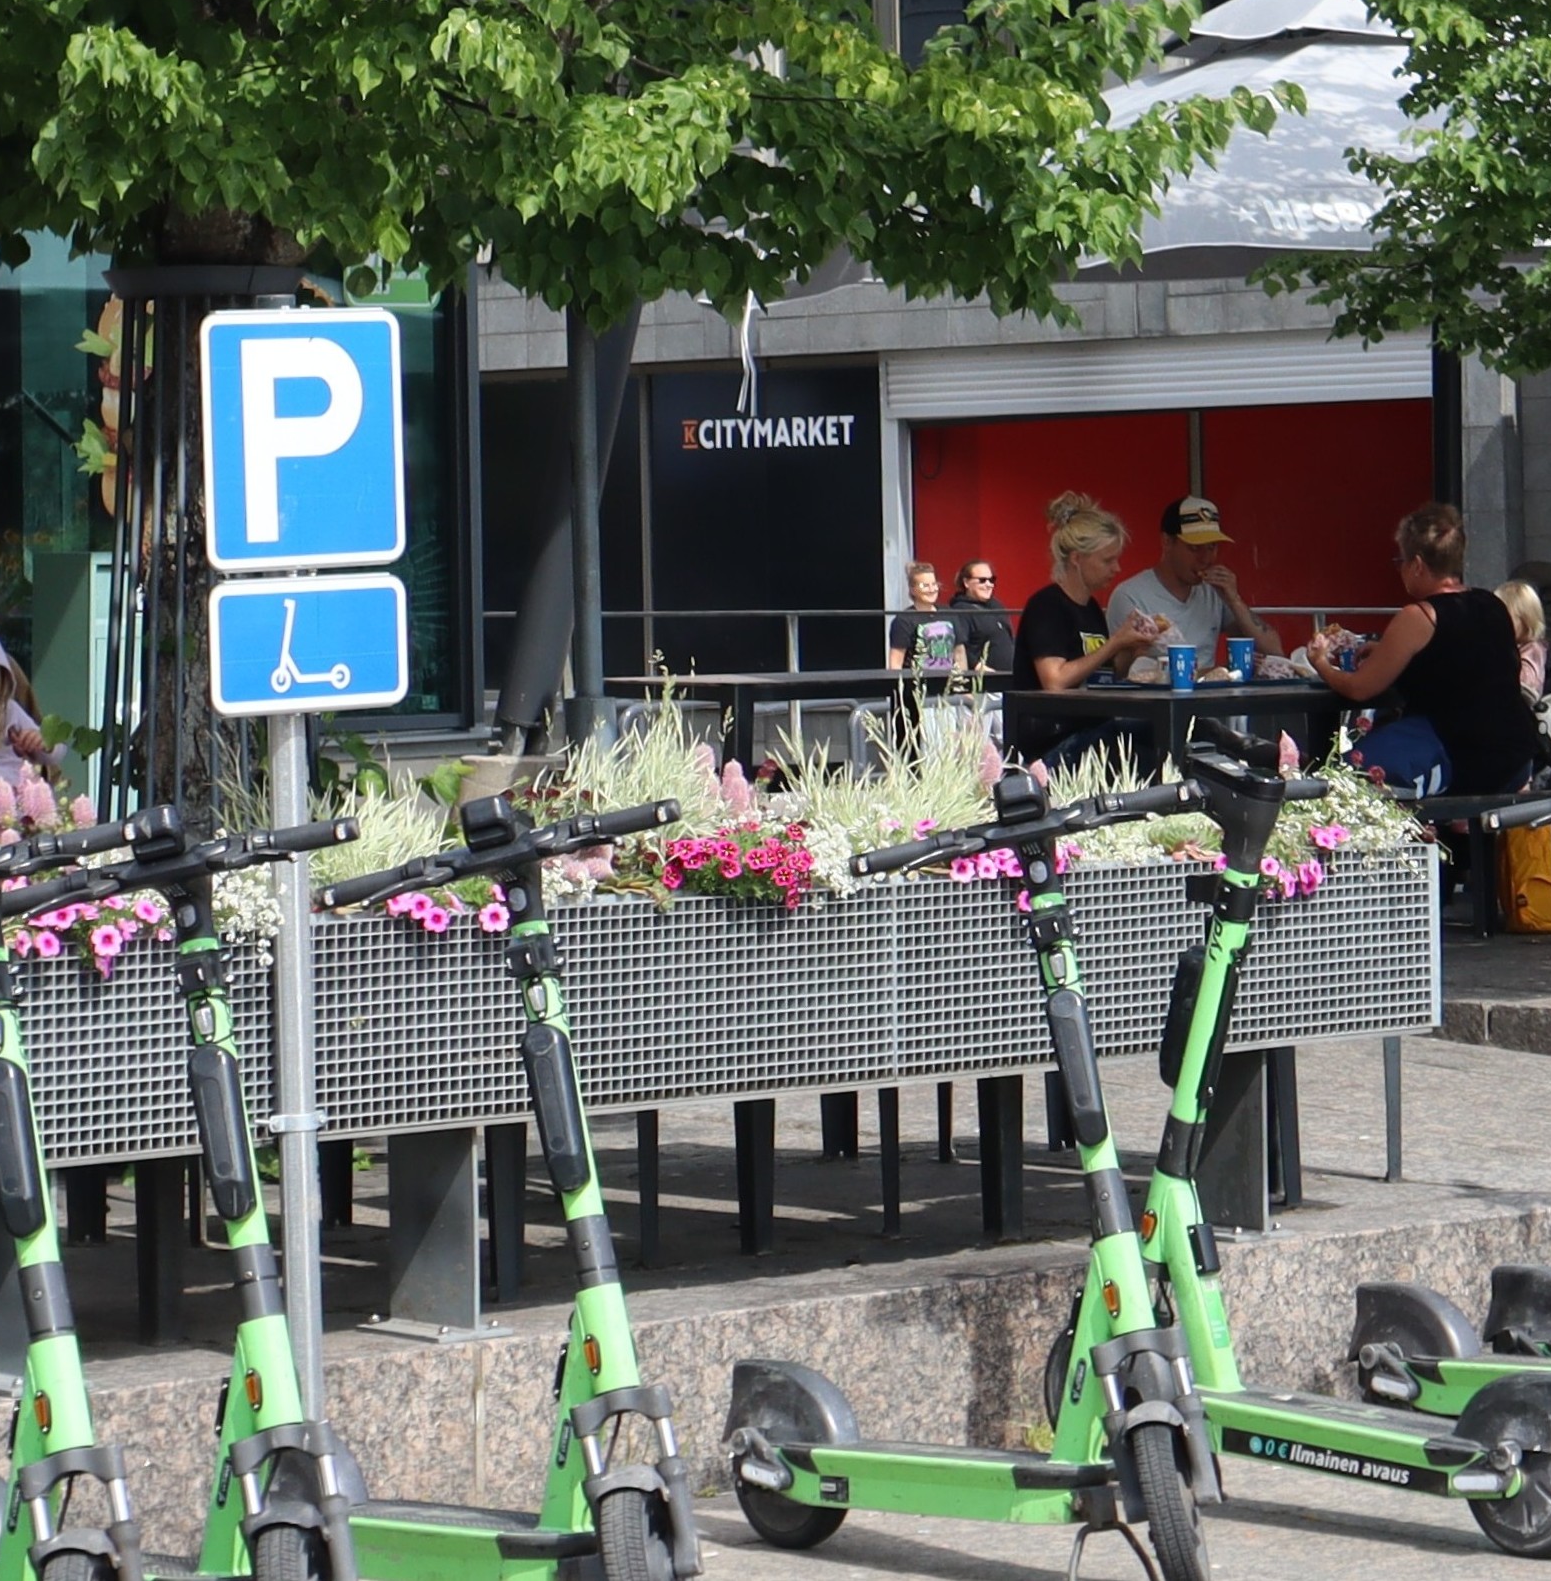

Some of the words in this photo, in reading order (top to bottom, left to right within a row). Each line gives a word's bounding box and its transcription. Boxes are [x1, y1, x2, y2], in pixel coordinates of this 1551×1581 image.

[241, 337, 363, 543] P
[1289, 1444, 1360, 1474] Ilmainen
[1361, 1464, 1410, 1485] avaus
